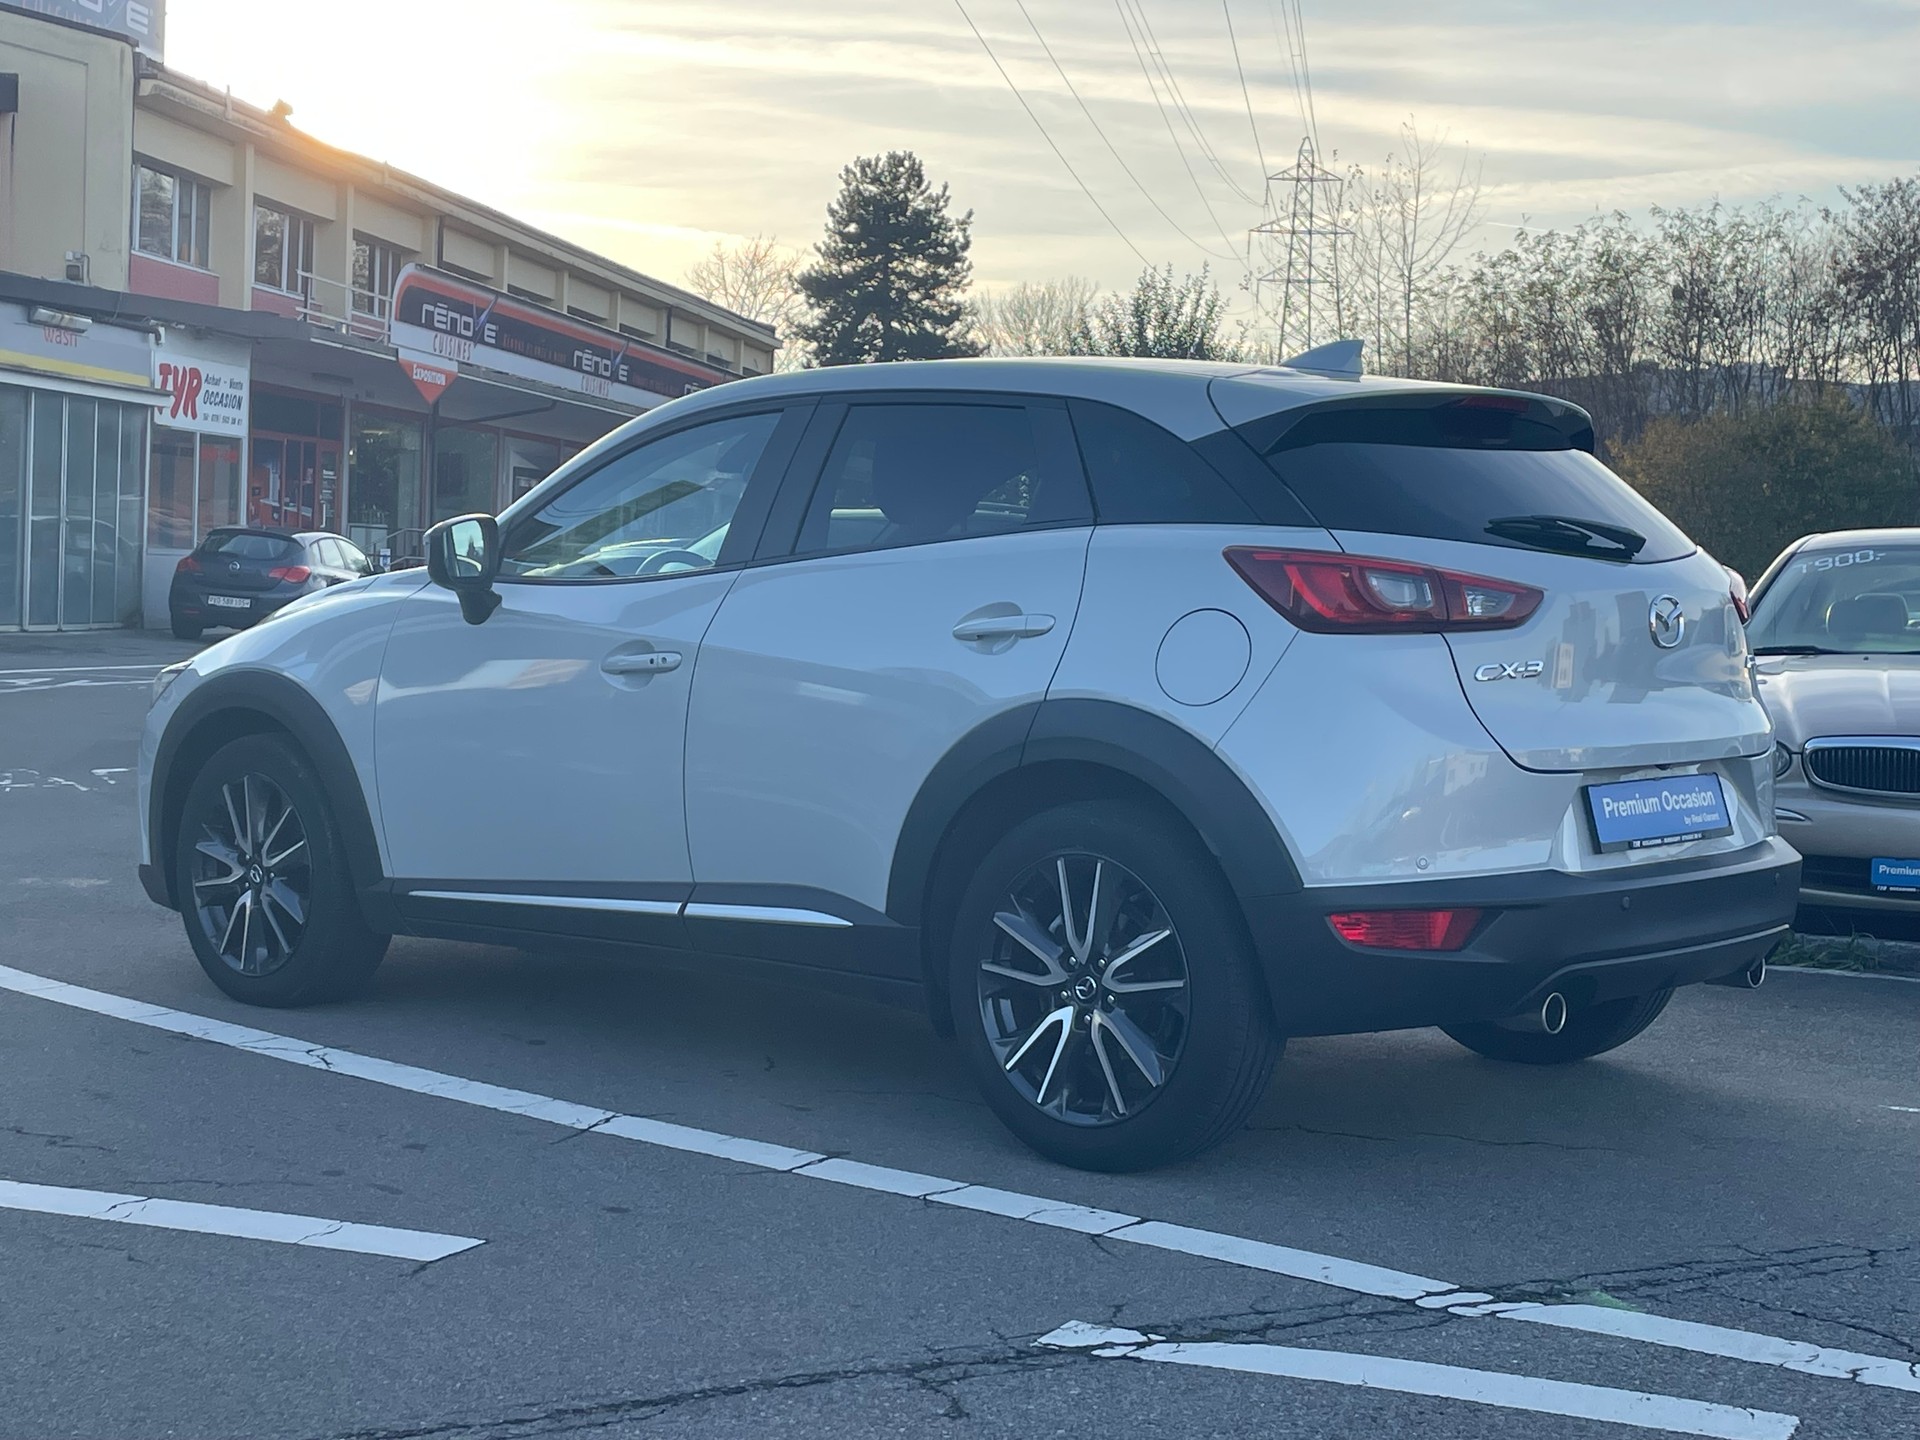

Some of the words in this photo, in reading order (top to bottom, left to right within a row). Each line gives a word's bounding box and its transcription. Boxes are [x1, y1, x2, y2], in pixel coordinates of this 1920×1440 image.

[433, 332, 472, 361] CUISINES
[157, 363, 202, 420] TYR
[202, 389, 243, 411] OCCASION
[1474, 660, 1544, 682] CX-3
[1602, 793, 1662, 818] Premium
[1661, 787, 1717, 811] Occasion
